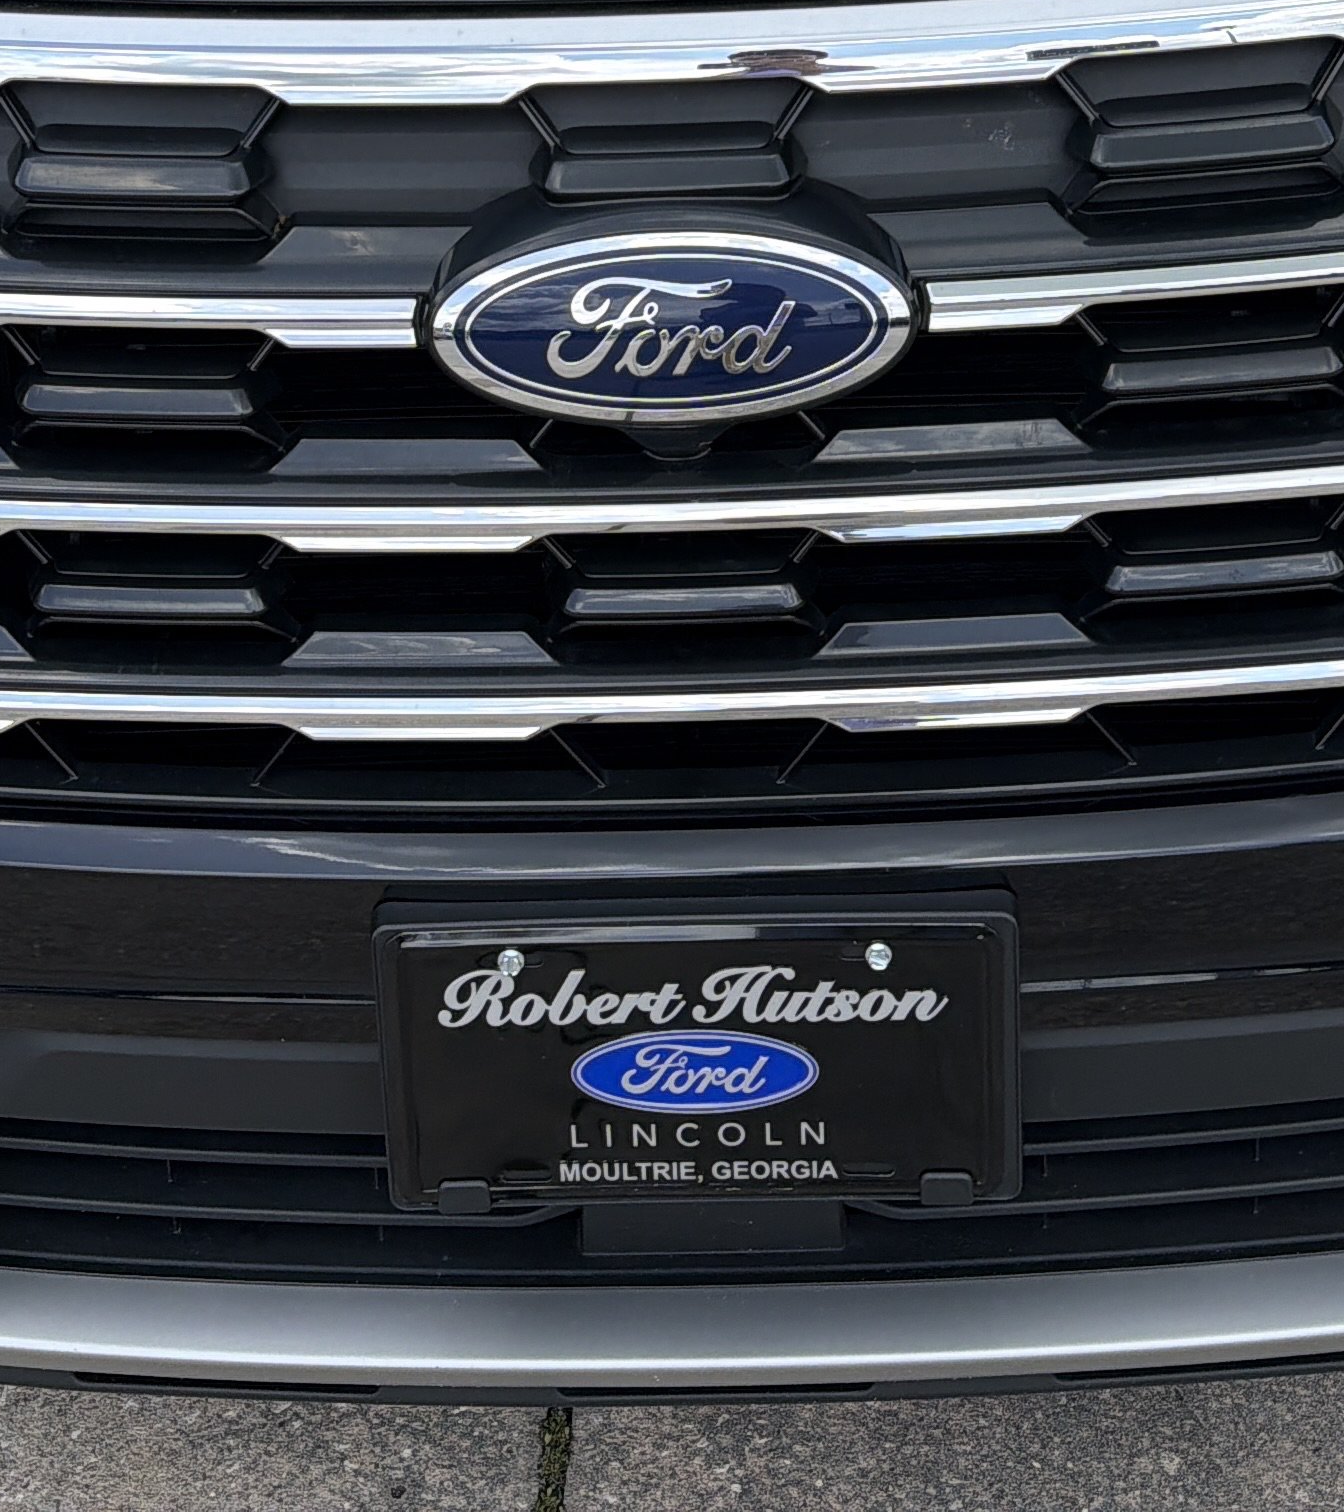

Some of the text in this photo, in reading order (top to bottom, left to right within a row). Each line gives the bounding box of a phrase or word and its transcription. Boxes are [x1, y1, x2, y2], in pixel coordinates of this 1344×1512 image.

[546, 277, 797, 379] Ford
[437, 965, 949, 1030] Robert Hutson
[620, 1044, 767, 1097] Ford
[570, 1121, 827, 1149] LINCOLN
[559, 1160, 838, 1183] MOULTRIE, GEORGIA
